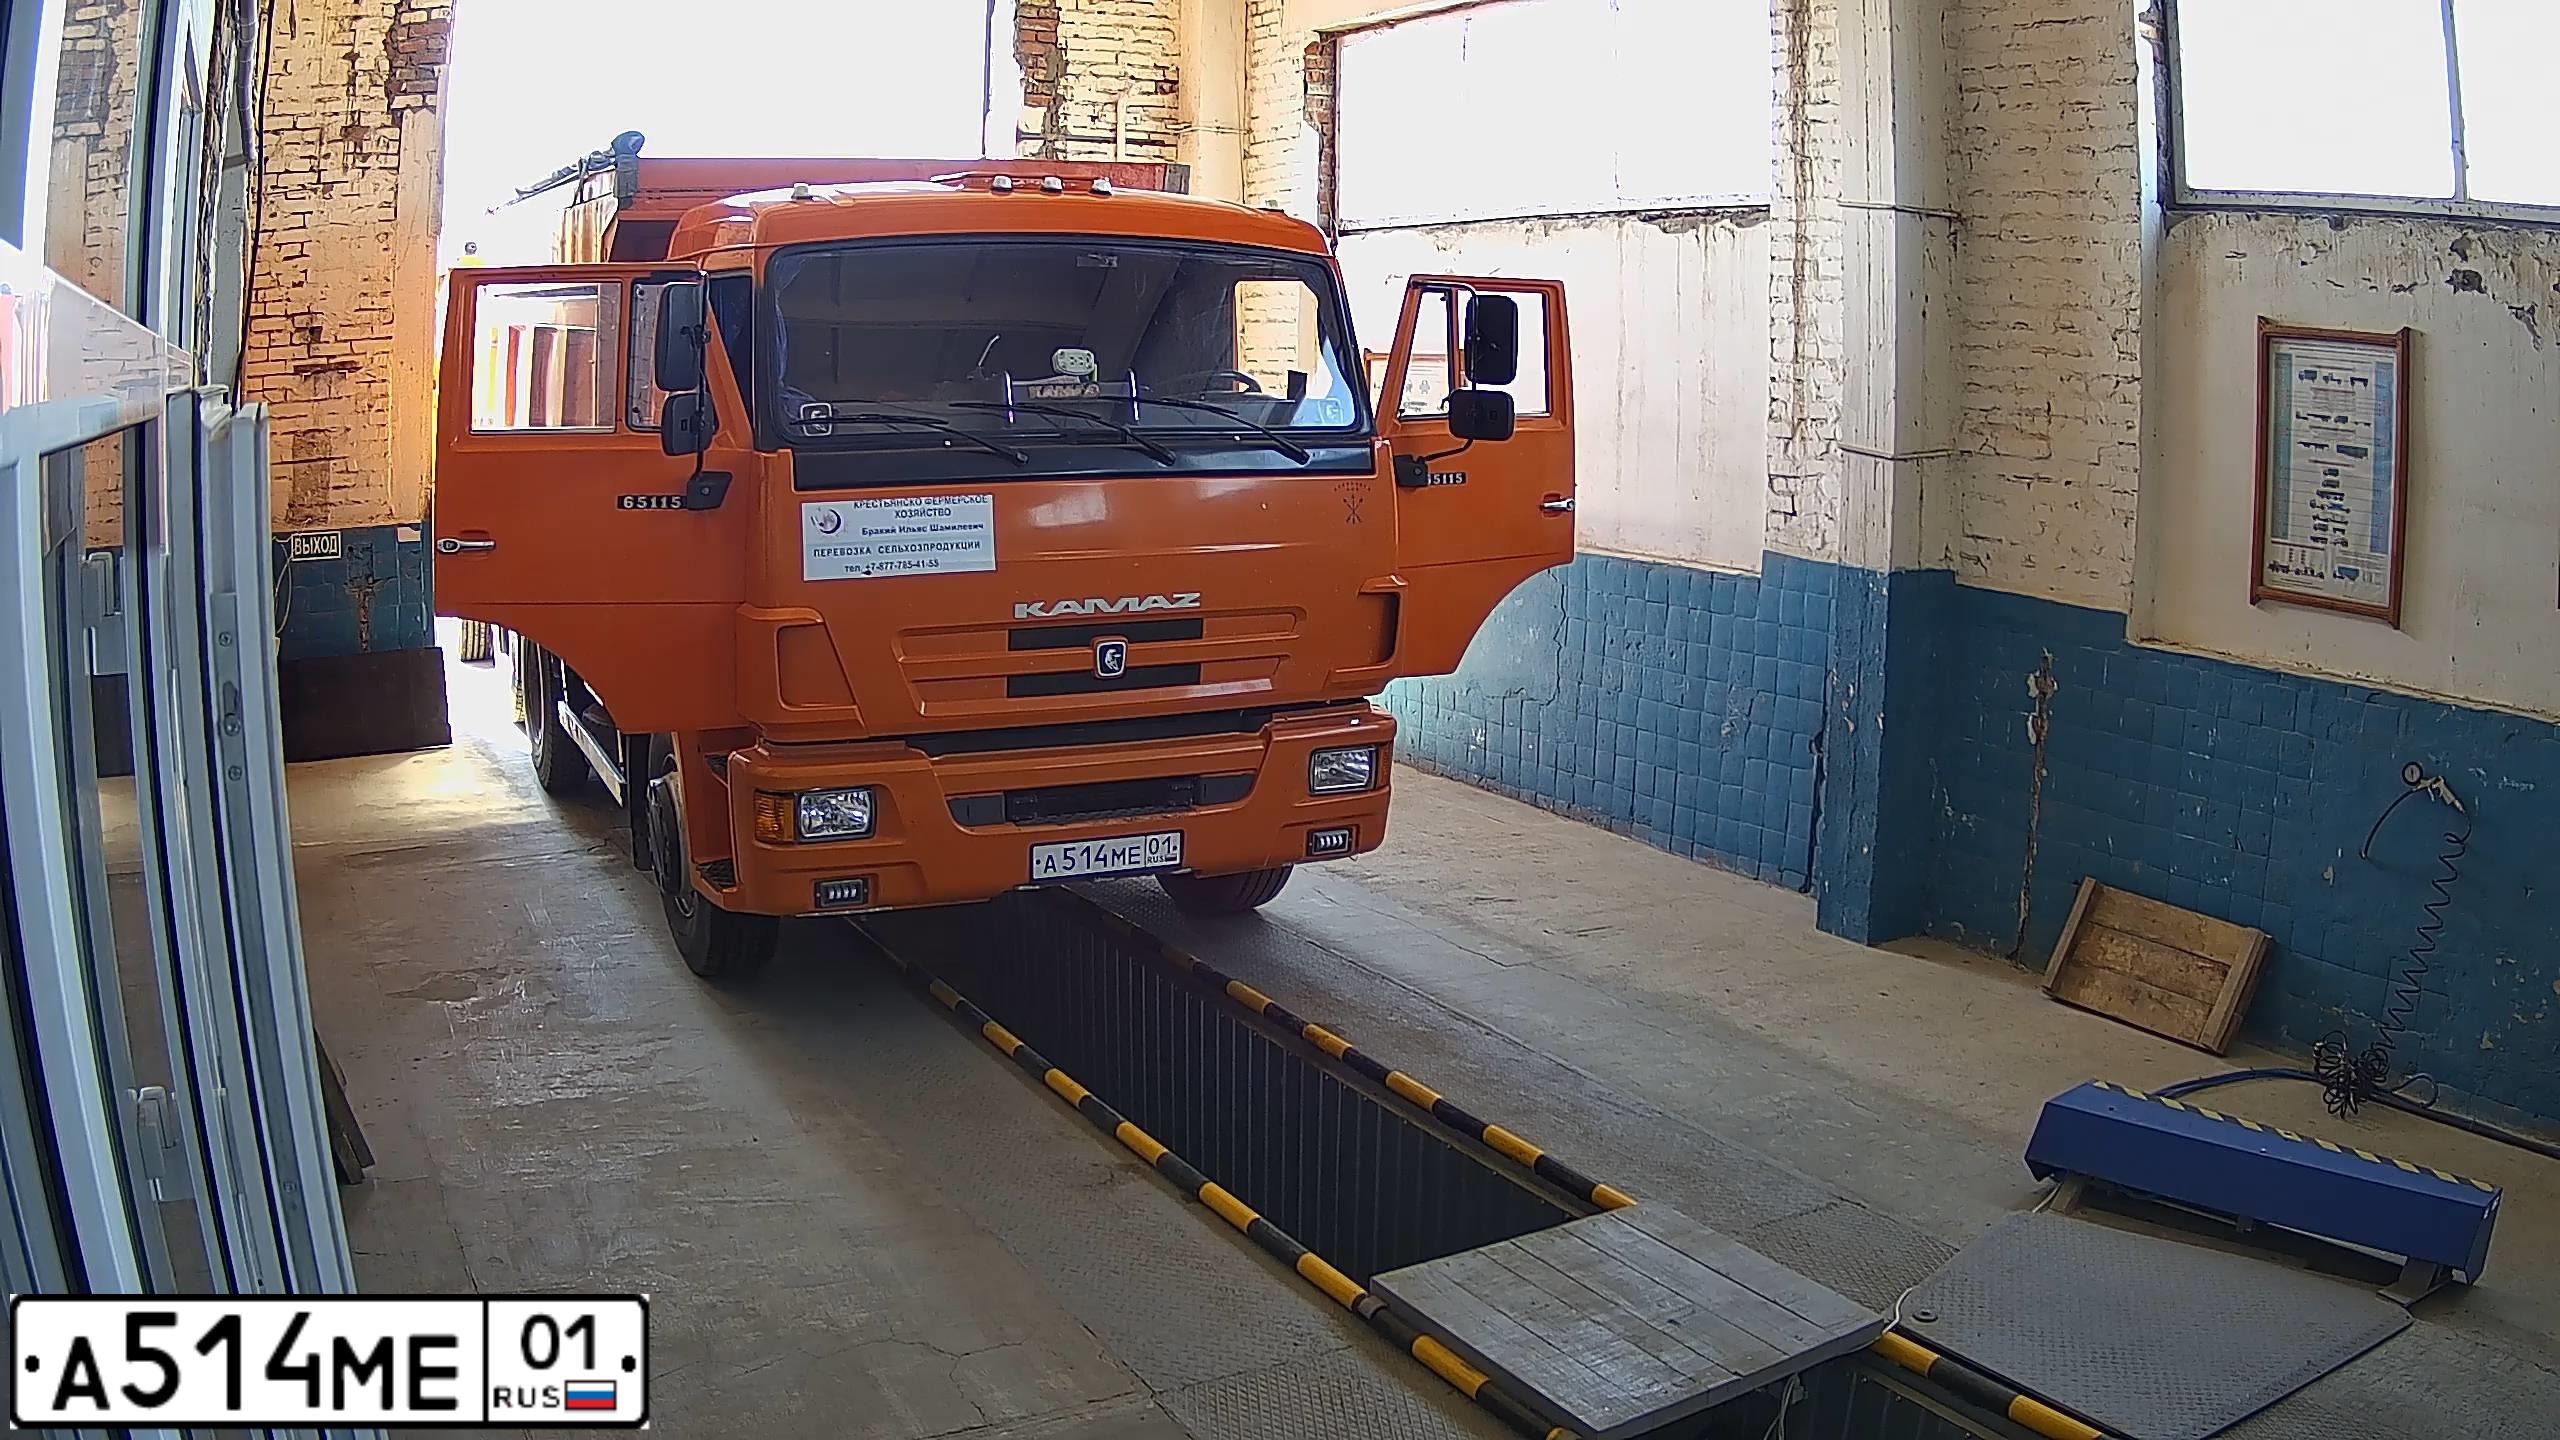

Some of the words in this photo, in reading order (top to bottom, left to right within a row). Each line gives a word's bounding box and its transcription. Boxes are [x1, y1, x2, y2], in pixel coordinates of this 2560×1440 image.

[623, 496, 681, 508] 65115
[853, 498, 922, 509] КРЕСТЬЯНСКО
[924, 495, 988, 506] ФЕРМЕРСКОЕ
[895, 507, 952, 519] ХОЗЯЙСТВО
[899, 524, 927, 534] Ильяс
[294, 535, 338, 555] ВЫХОД
[813, 545, 872, 558] ПЕРЕВОЗКА
[878, 540, 981, 555] СЕЛЬХОЗПРОДУКЦИИ
[1014, 592, 1201, 619] KAMAZ
[1148, 835, 1172, 855] 01
[1147, 855, 1164, 864] RUS
